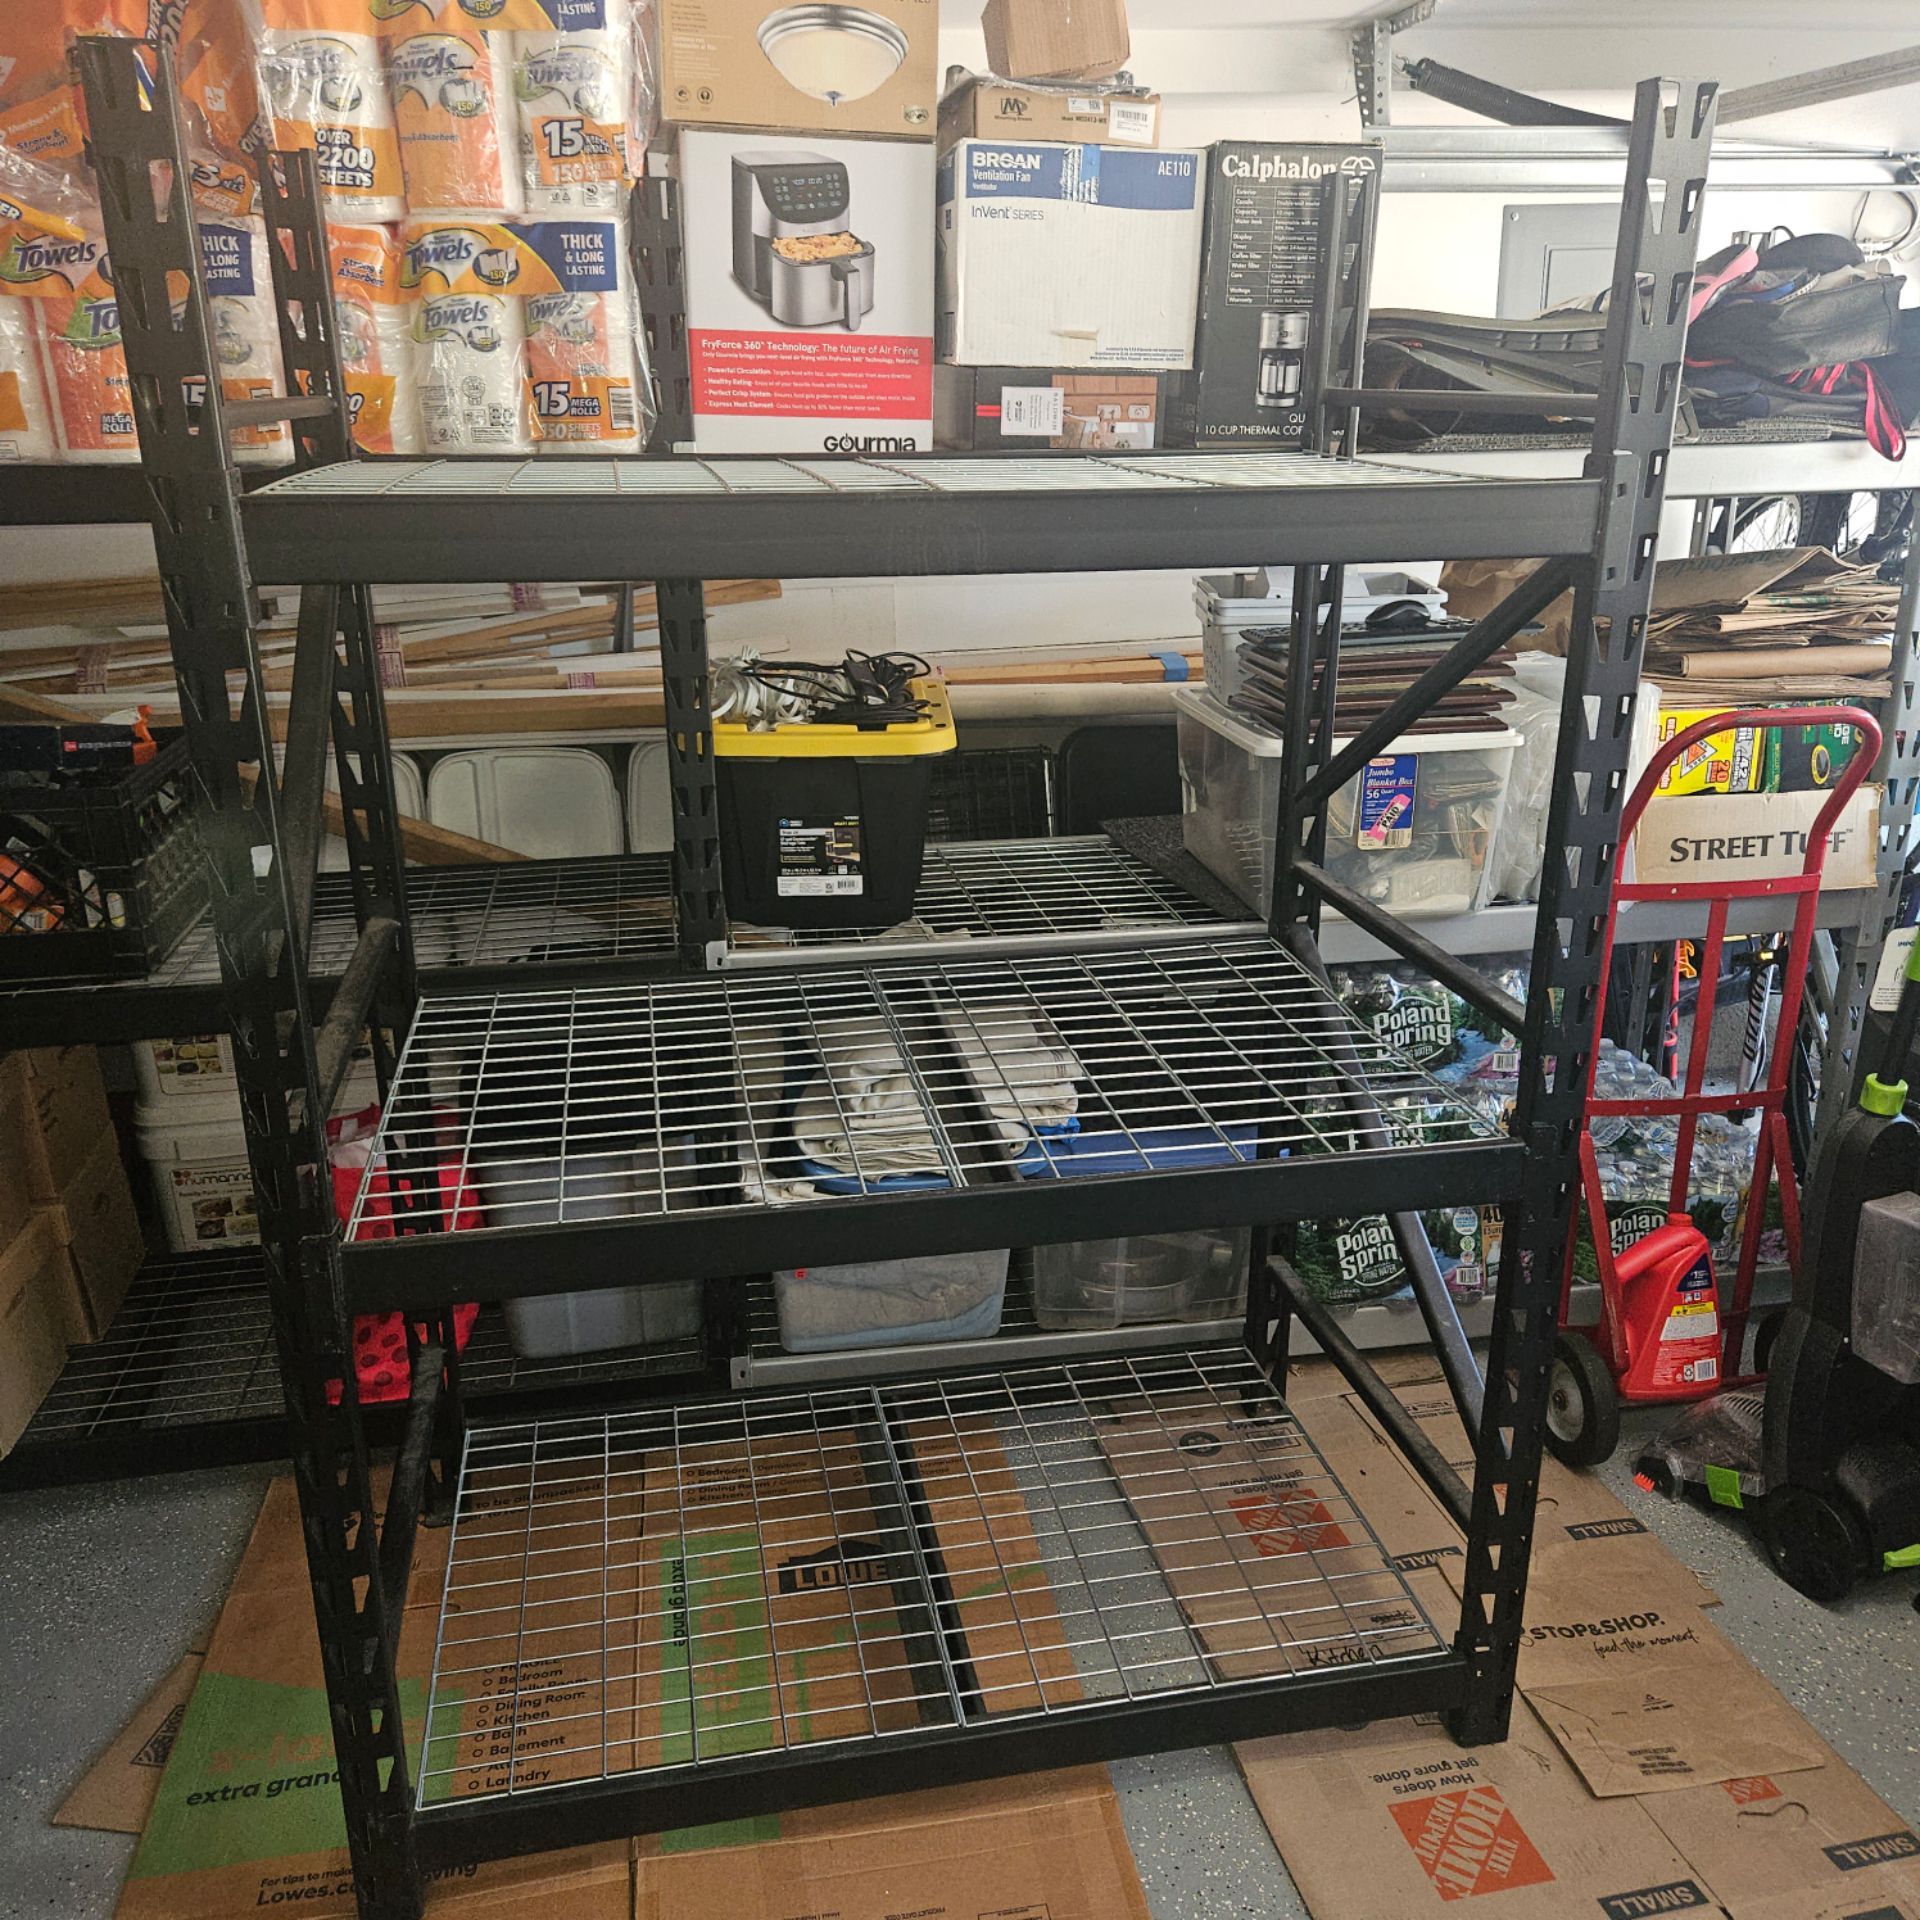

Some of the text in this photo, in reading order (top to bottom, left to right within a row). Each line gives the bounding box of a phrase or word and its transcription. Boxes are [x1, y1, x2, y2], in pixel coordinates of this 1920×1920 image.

[557, 4, 596, 15] LASTING
[315, 132, 352, 145] OVER
[542, 118, 585, 158] 15
[317, 146, 374, 171] 2200
[972, 151, 1041, 170] BROAN
[1221, 154, 1337, 182] Calphalon
[972, 170, 1031, 182] Ventilation Fan
[1157, 160, 1191, 177] AE110
[319, 170, 373, 188] SHEETS
[971, 204, 1044, 221] InVent SERIES
[202, 234, 240, 253] HICK
[560, 234, 604, 250] THICK
[14, 241, 96, 275] Towels
[210, 254, 240, 267] LONG
[340, 257, 373, 273] Strong
[405, 237, 475, 275] Towels
[564, 251, 605, 264] & LONG
[205, 267, 241, 280] ASTING
[565, 264, 606, 277] LASTING
[422, 299, 489, 332] Towels
[702, 339, 743, 352] FryForce
[766, 342, 820, 355] Technology:
[822, 343, 838, 354] The
[839, 344, 866, 355] future
[867, 344, 877, 354] of
[879, 345, 892, 355] Air
[893, 346, 920, 358] Frying
[532, 380, 571, 417] 15
[570, 396, 600, 408] MEGA
[101, 413, 132, 425] MEGA
[570, 406, 601, 417] ROLLS
[102, 423, 134, 435] ROLL
[1204, 424, 1217, 435] 10
[1218, 425, 1238, 436] CUP
[1239, 425, 1281, 437] THERMAL
[1366, 768, 1395, 778] Jumbo
[1717, 759, 1731, 783] 20
[1367, 777, 1397, 787] Blanket
[1366, 789, 1380, 799] 56
[1381, 805, 1401, 829] PAID
[1670, 834, 1775, 863] STREET
[1372, 999, 1451, 1039] Poland
[1610, 1212, 1666, 1237] Polan
[1336, 1222, 1394, 1260] Polan
[1611, 1231, 1648, 1257] Spri
[1338, 1240, 1399, 1281] Sprin
[697, 1465, 749, 1478] Bedroom
[699, 1492, 744, 1503] Kitchen
[1572, 1519, 1638, 1538] SMALL
[1594, 1640, 1622, 1659] feed
[1621, 1635, 1646, 1652] the
[498, 1668, 564, 1685] Bedroom
[492, 1726, 528, 1741] Bah
[1367, 1756, 1479, 1784] get more done.
[1393, 1771, 1475, 1795] How doers
[186, 1781, 261, 1808] extra
[1413, 1788, 1520, 1899] THE HOME DEPOT
[1831, 1836, 1919, 1865] SMALL
[260, 1875, 281, 1889] For
[282, 1873, 306, 1888] tips
[307, 1872, 320, 1883] to
[255, 1879, 357, 1908] Lowes.co
[1609, 1884, 1697, 1918] SMALL
